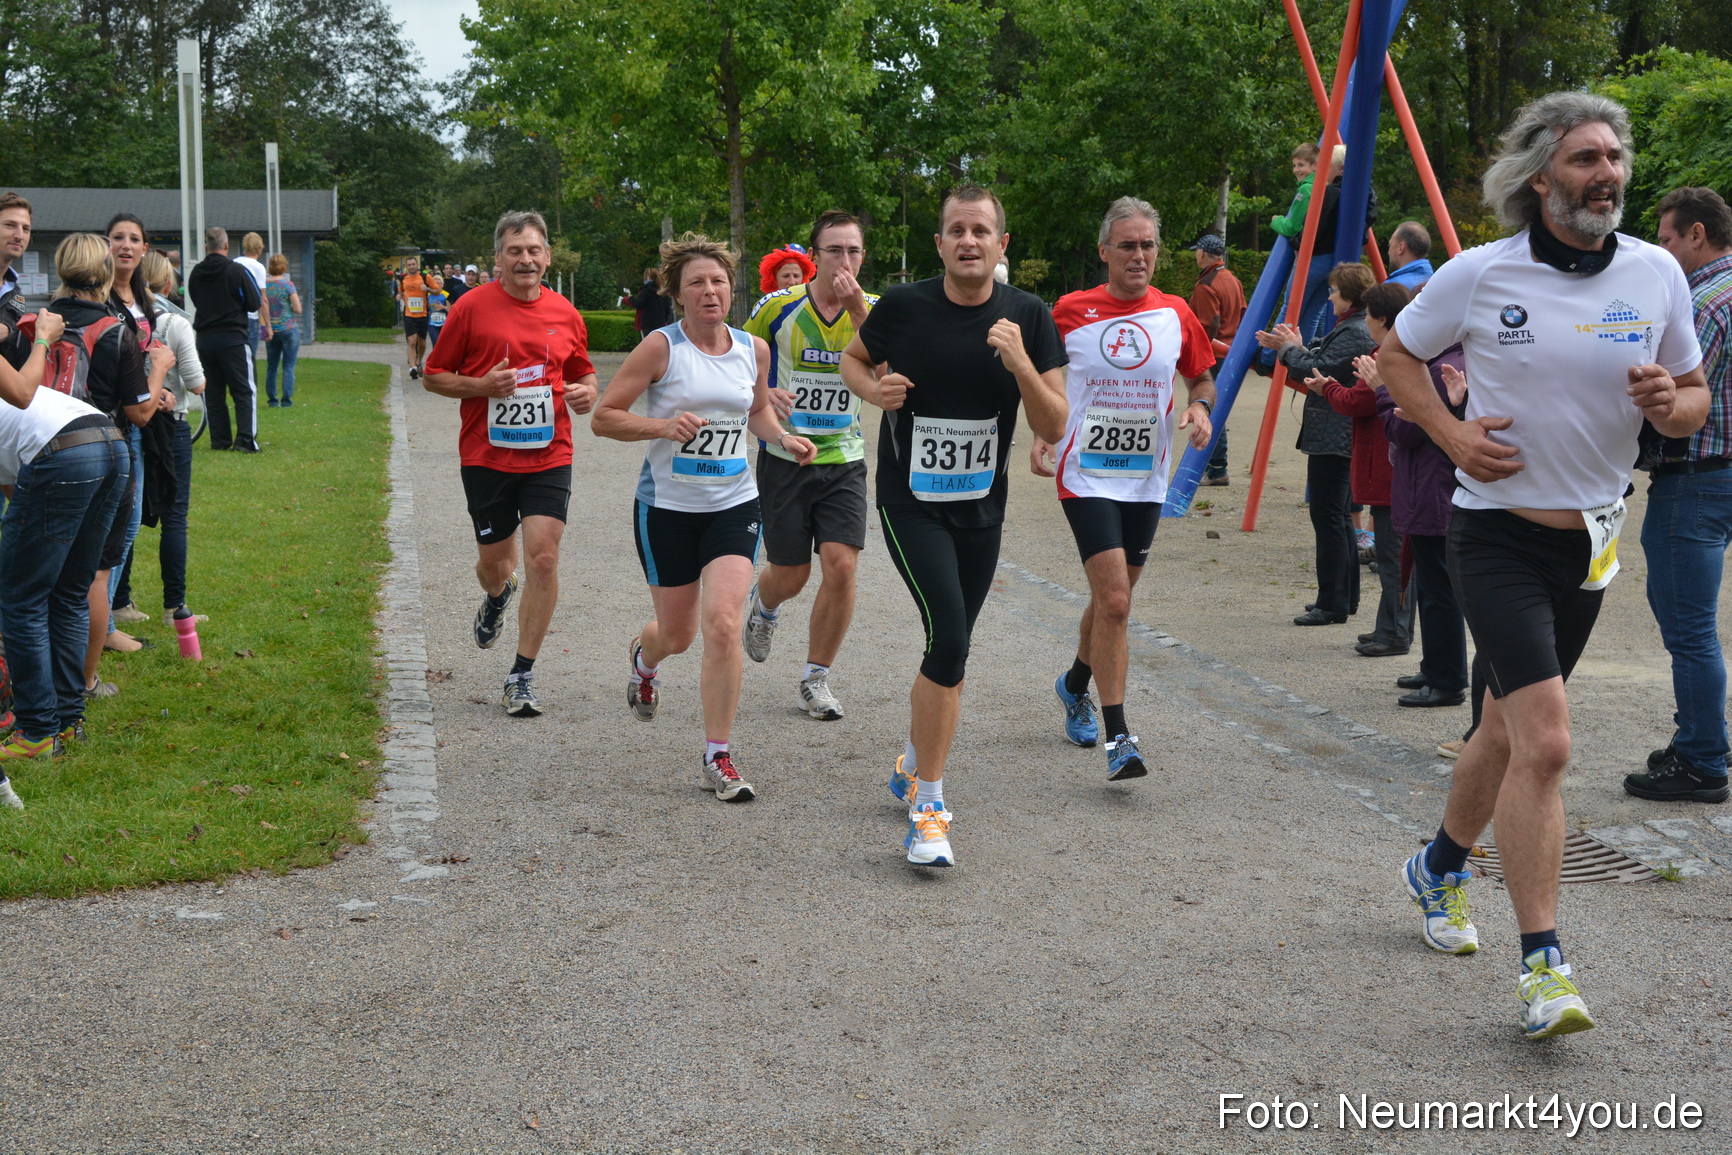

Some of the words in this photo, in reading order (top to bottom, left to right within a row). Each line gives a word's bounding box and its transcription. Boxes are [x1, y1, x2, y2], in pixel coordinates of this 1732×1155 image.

[1574, 324, 1595, 333] 14.
[1498, 330, 1534, 340] PARTL
[795, 387, 850, 412] 2879
[1092, 400, 1156, 410] Leistungsdiagnostik
[495, 401, 546, 425] 2231
[1086, 414, 1110, 423] PARTL
[806, 416, 835, 426] Tobias
[915, 425, 944, 435] PARTL
[946, 428, 988, 436] Neumarkt
[502, 431, 542, 442] Wolfgang
[1088, 425, 1151, 452] 2835
[681, 430, 742, 456] 2277
[921, 439, 991, 470] 3314
[1103, 457, 1130, 467] Josef
[697, 462, 725, 474] Maria
[932, 476, 976, 490] HANS
